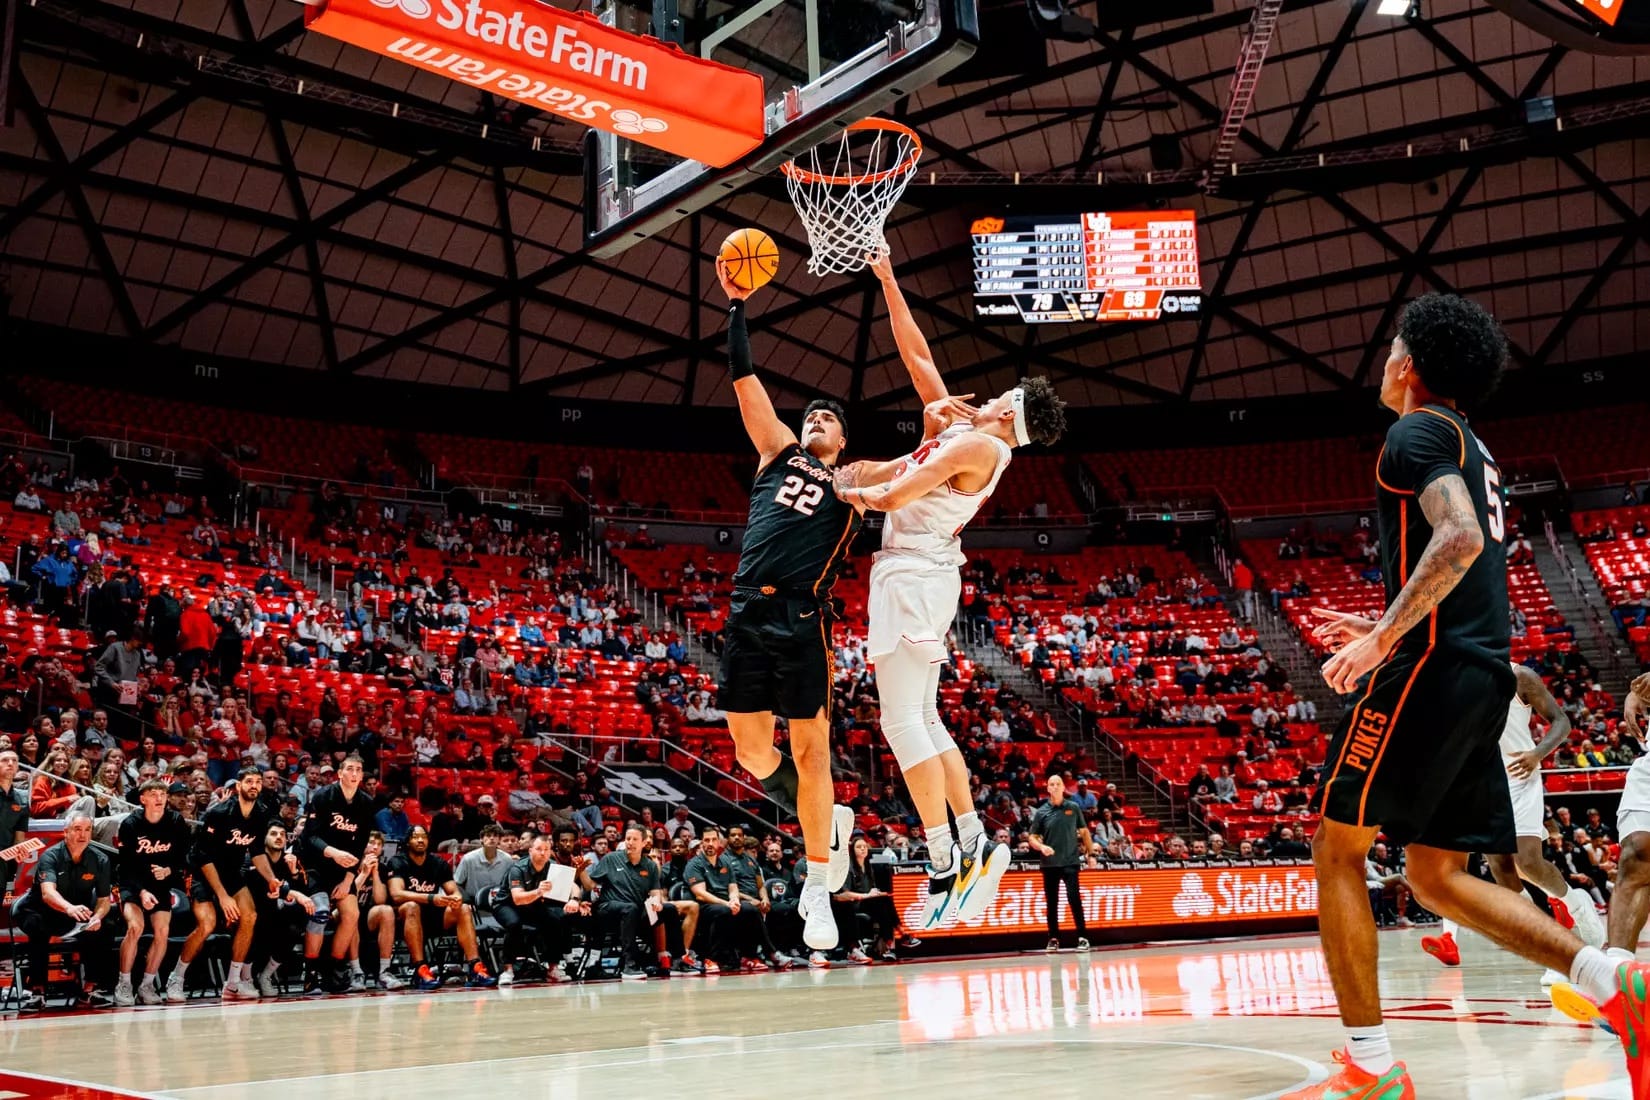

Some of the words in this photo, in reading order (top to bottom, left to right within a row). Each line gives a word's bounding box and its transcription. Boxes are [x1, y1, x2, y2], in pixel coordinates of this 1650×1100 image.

[1031, 293, 1054, 311] 79
[195, 364, 218, 379] nn
[562, 408, 582, 421] pp
[896, 421, 916, 433] qq
[775, 475, 825, 516] 22
[1483, 461, 1505, 543] 5
[383, 507, 395, 519] N
[1360, 517, 1370, 528] R
[719, 531, 729, 542] P
[1038, 534, 1048, 544] Q
[1345, 707, 1388, 772] POKES
[136, 838, 172, 854] Pokes
[408, 877, 436, 893] Pokes
